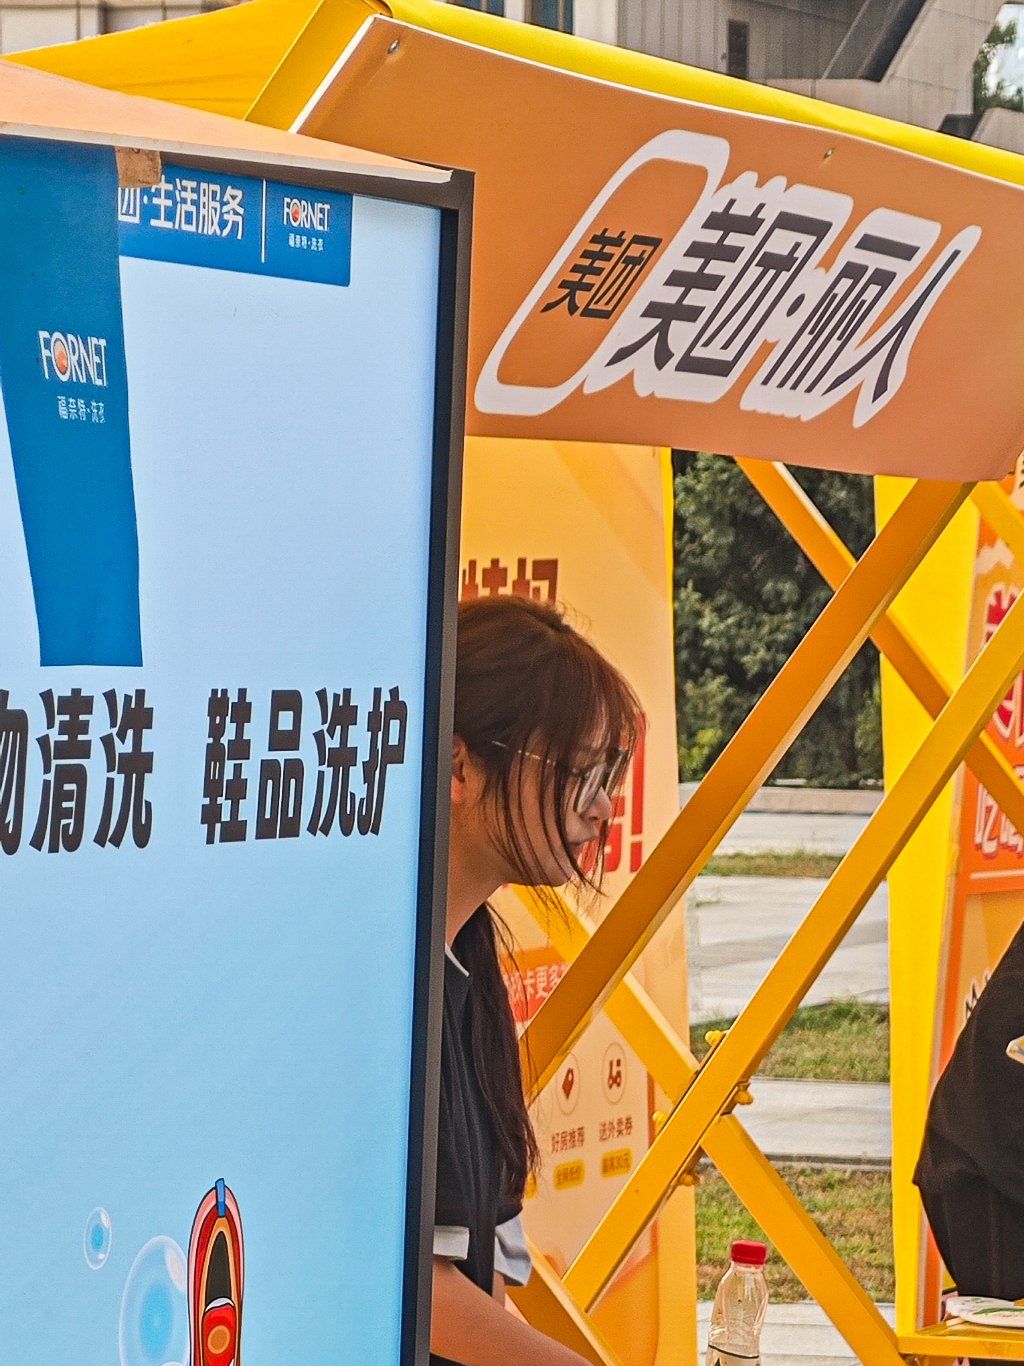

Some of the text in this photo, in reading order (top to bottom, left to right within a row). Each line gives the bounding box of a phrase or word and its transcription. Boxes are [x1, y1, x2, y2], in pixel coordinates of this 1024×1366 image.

[283, 197, 331, 232] FORNET
[540, 228, 663, 320] 美团
[605, 197, 961, 406] 美团·丽人
[38, 329, 108, 388] FORNET
[200, 686, 408, 845] 鞋品洗护
